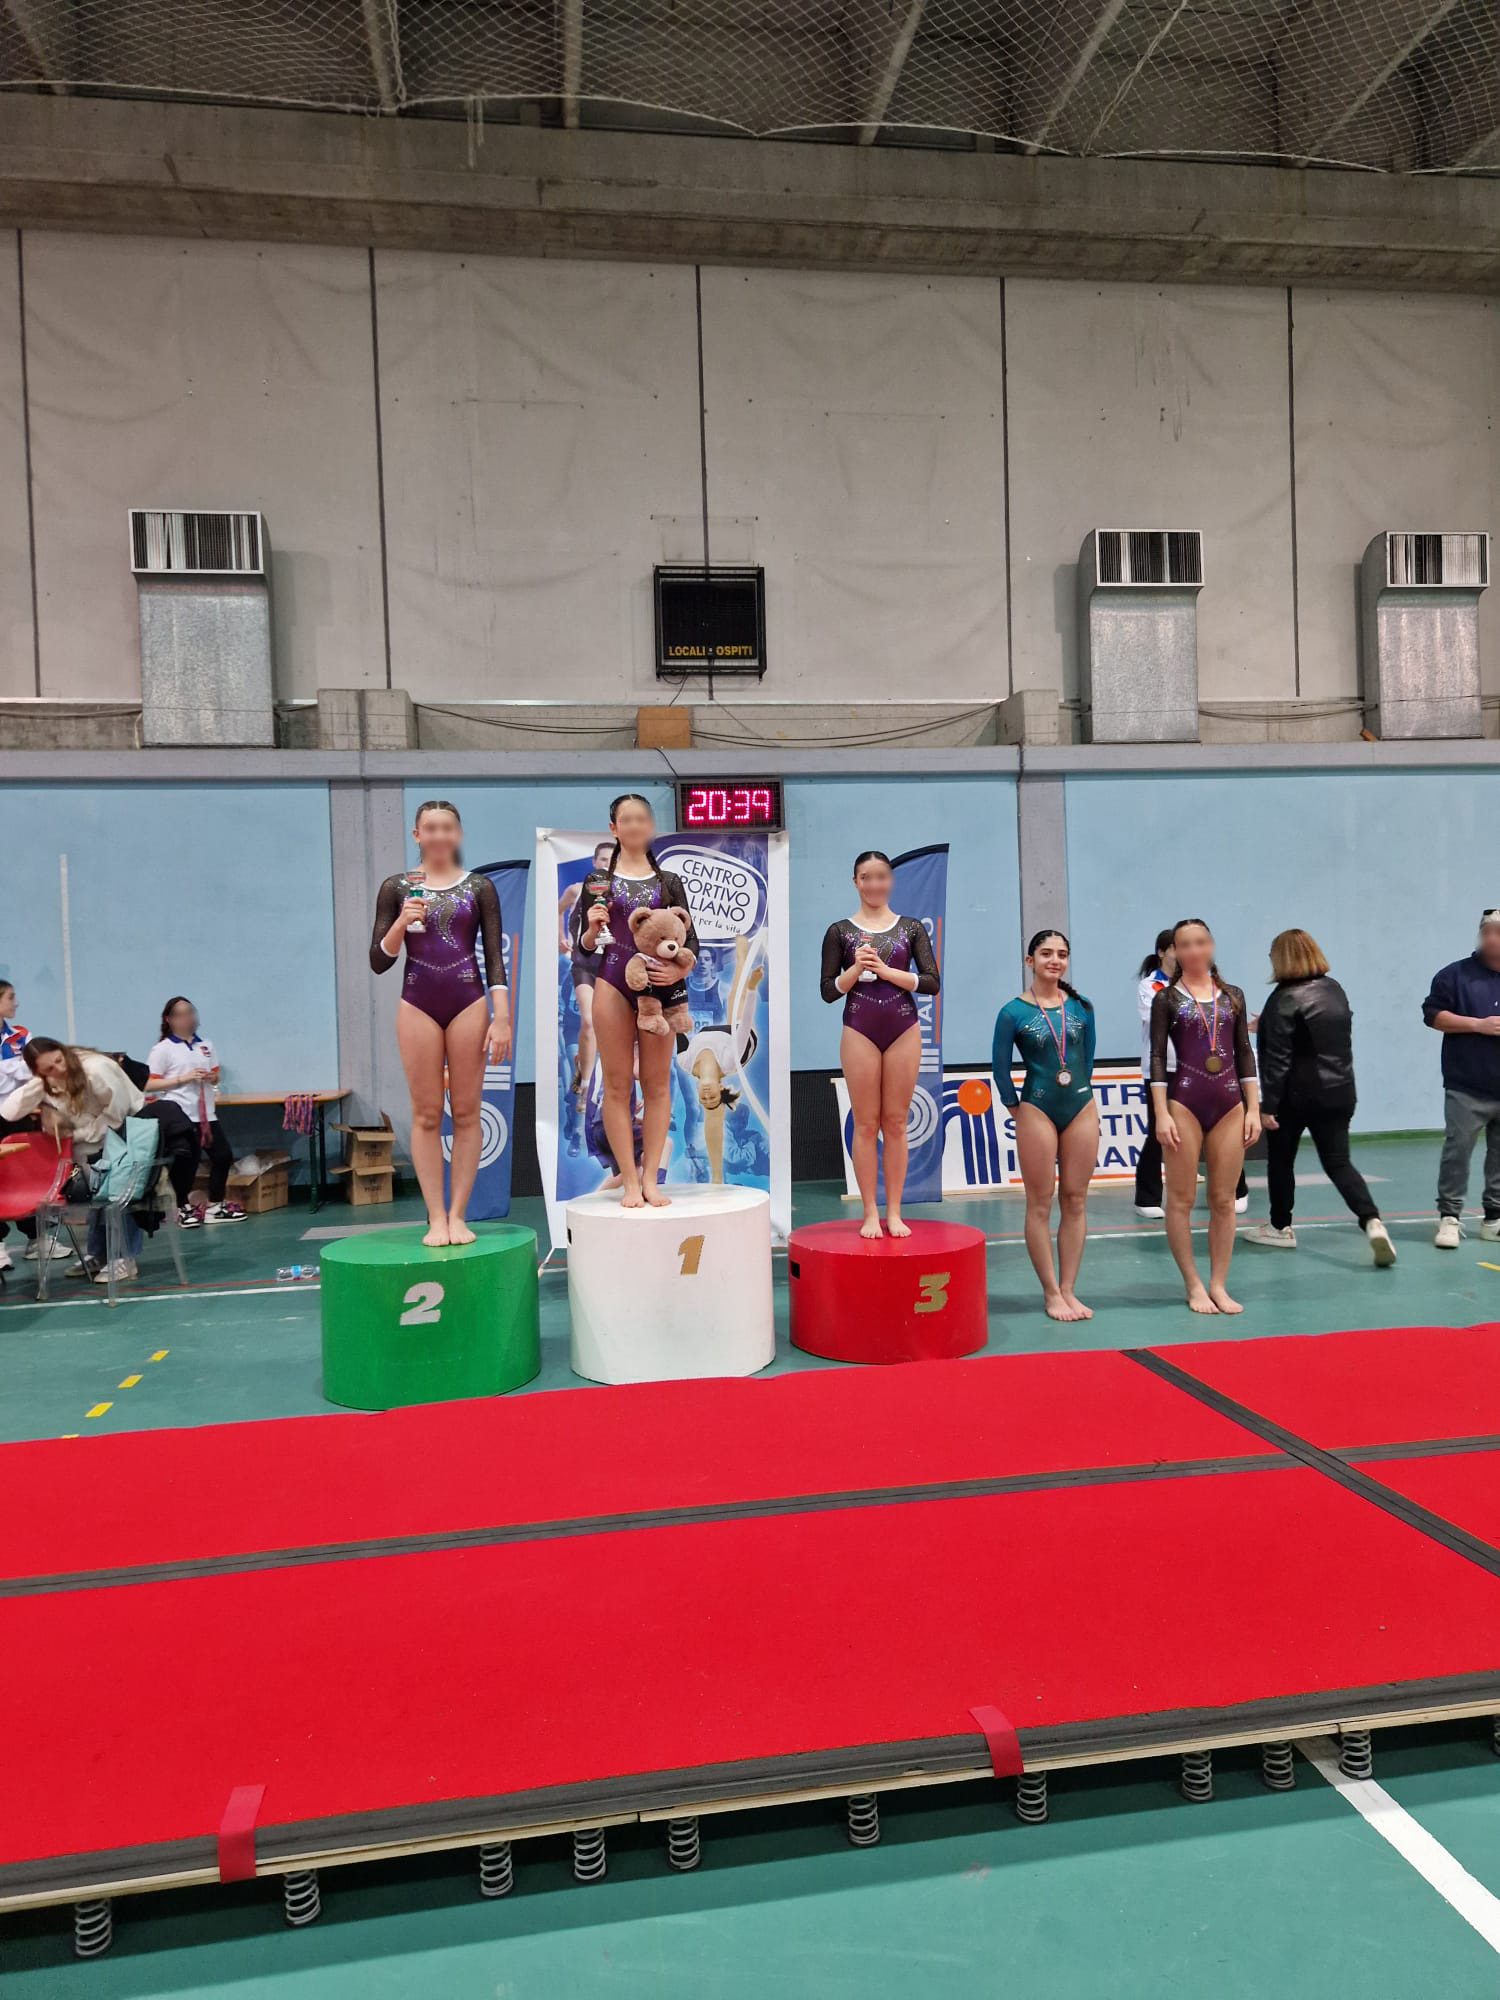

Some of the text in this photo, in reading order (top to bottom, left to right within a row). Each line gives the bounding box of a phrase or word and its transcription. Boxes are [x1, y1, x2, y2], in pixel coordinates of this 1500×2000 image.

[668, 645, 753, 656] LOCALI OSPITI
[688, 789, 770, 820] 20:39
[682, 859, 747, 888] CENTRO
[680, 875, 750, 907] PORTIVO
[690, 895, 745, 922] LIANO
[699, 917, 712, 927] per
[715, 919, 722, 929] la
[726, 922, 741, 934] vita
[678, 1235, 705, 1275] 1
[400, 1282, 445, 1325] 2
[914, 1272, 951, 1313] 3
